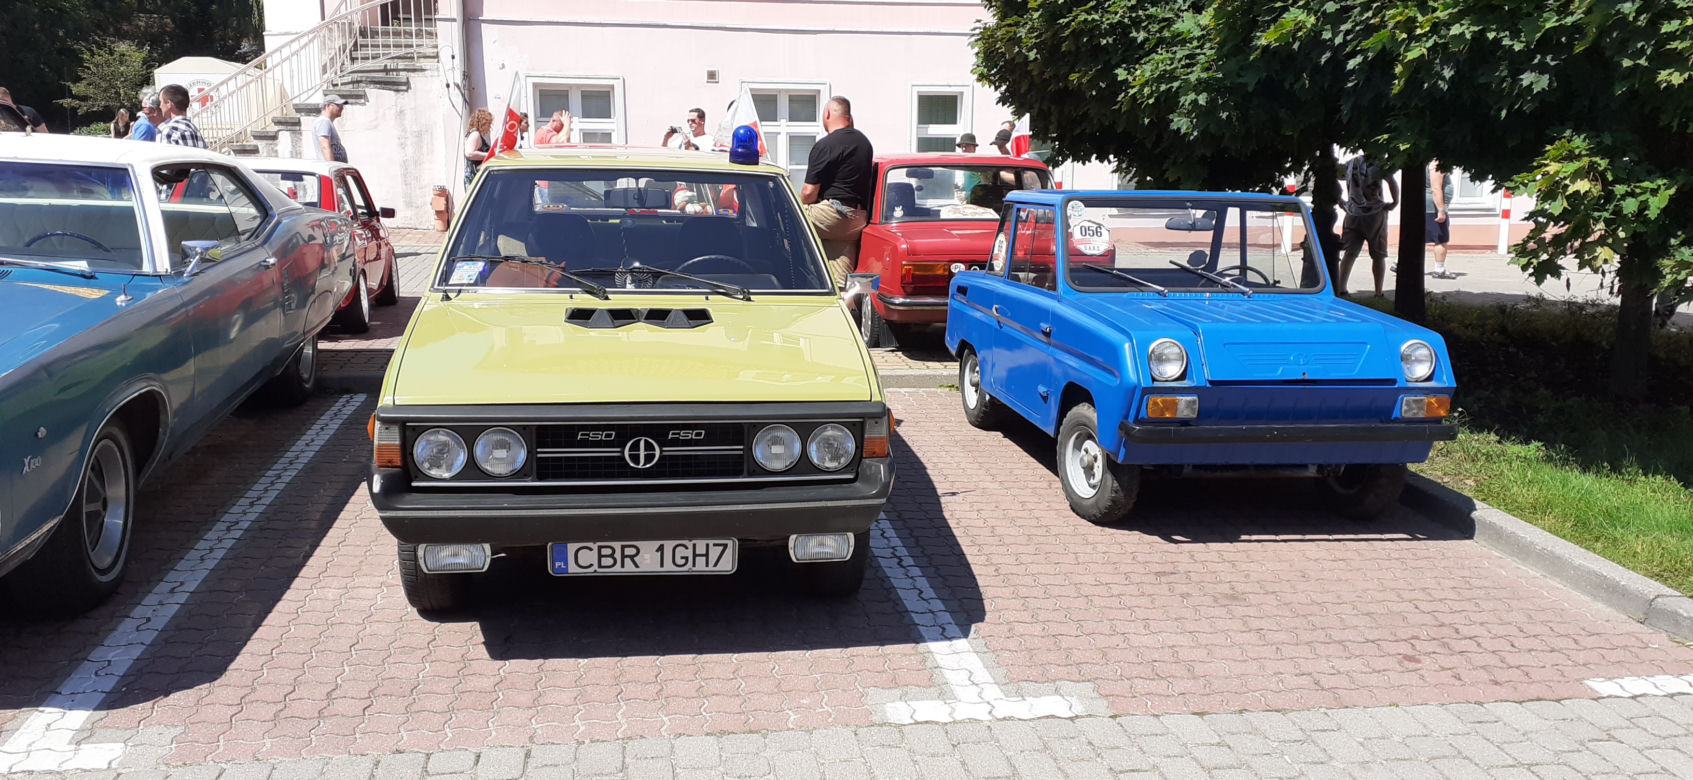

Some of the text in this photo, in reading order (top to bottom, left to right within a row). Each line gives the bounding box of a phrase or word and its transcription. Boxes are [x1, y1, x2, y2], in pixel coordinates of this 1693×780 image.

[1080, 225, 1103, 238] 056
[577, 430, 705, 441] FSO FSO
[573, 543, 729, 570] CBR 1GH7
[555, 561, 567, 569] PL
